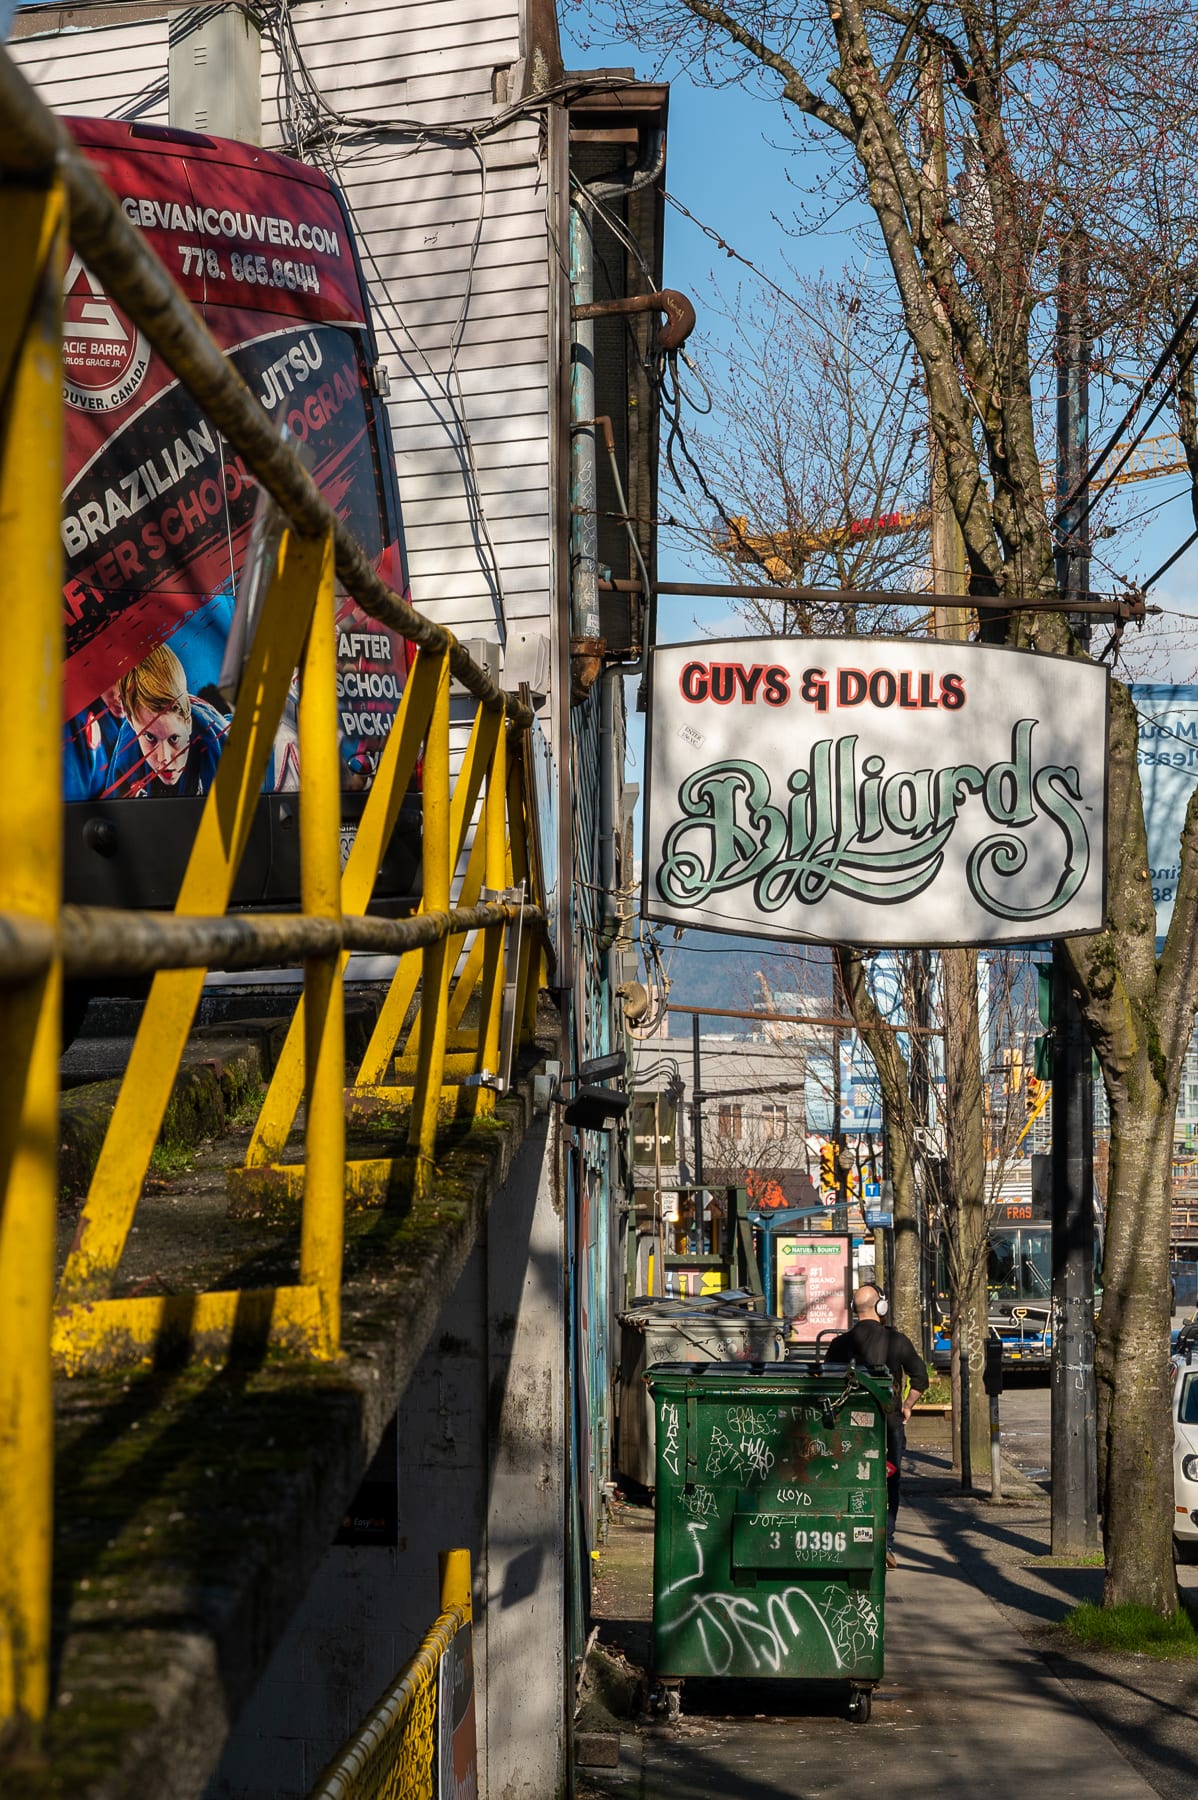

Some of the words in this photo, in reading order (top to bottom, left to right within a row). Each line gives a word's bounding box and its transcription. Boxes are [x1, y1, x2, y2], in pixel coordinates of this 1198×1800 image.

[121, 198, 340, 256] GBVANCOUVER.COM
[178, 246, 226, 280] 778.
[230, 251, 320, 294] 865.8644
[85, 358, 110, 367] GRACIE
[90, 343, 127, 357] BARRA
[110, 359, 146, 405] CANADA
[60, 419, 217, 558] BRAZILIAN
[141, 455, 258, 560] SCHOOL
[338, 633, 391, 660] AFTER
[336, 673, 403, 699] SCHOOL
[679, 661, 791, 706] GUYS
[800, 667, 830, 713] &
[836, 666, 967, 710] DOLLS
[656, 718, 1091, 921] Billiards
[809, 1267, 823, 1277] #1
[769, 1531, 781, 1550] 3
[795, 1530, 847, 1552] 0396
